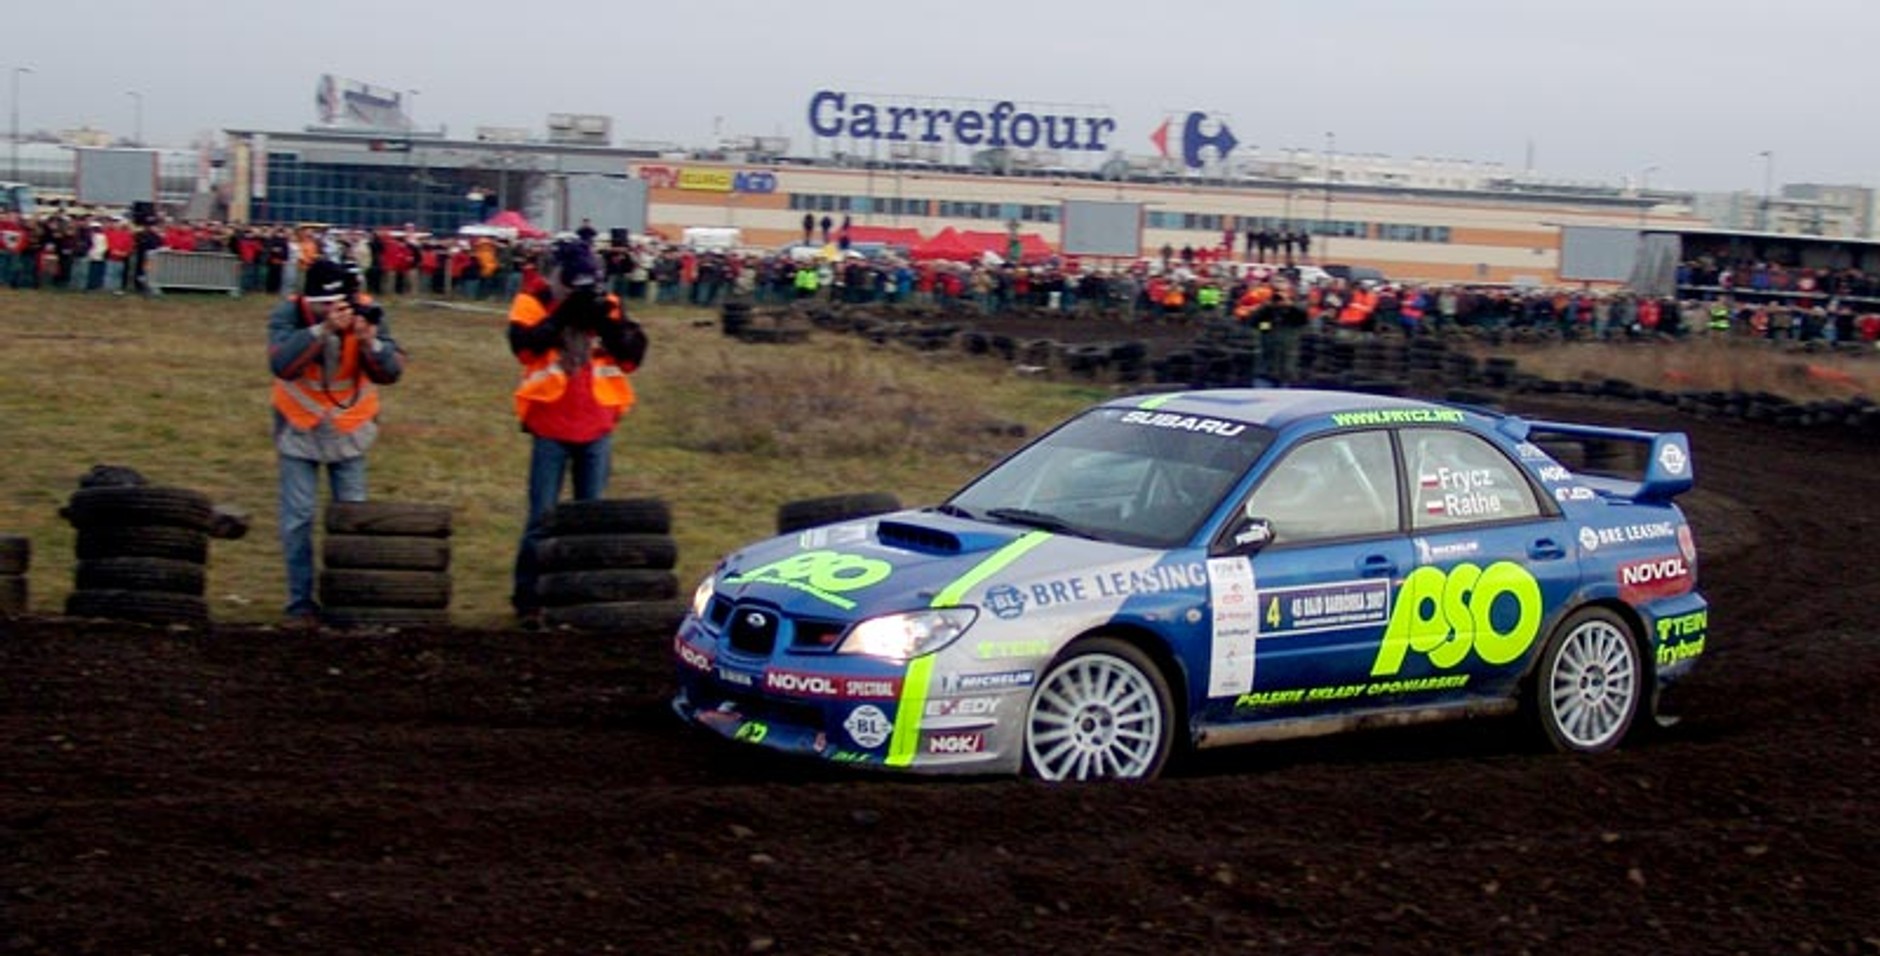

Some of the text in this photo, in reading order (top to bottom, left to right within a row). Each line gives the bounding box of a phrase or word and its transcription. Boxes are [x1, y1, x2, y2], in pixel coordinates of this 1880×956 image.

[808, 91, 1116, 151] Carrefour
[1121, 411, 1246, 436] SUBARU
[1332, 410, 1464, 426] WWW.FRYCZ.NET
[1438, 467, 1495, 491] Frycz
[1445, 492, 1501, 516] Rathe
[1626, 522, 1674, 541] LEASING
[1623, 559, 1688, 584] NOVOL
[1031, 563, 1207, 606] BRE LEASING
[1267, 597, 1280, 627] 4
[1370, 561, 1543, 677] PSO
[768, 673, 837, 694] NOVOL
[961, 672, 1033, 688] MICHELIN
[926, 699, 1001, 716] EXEDY
[857, 719, 881, 735] BL
